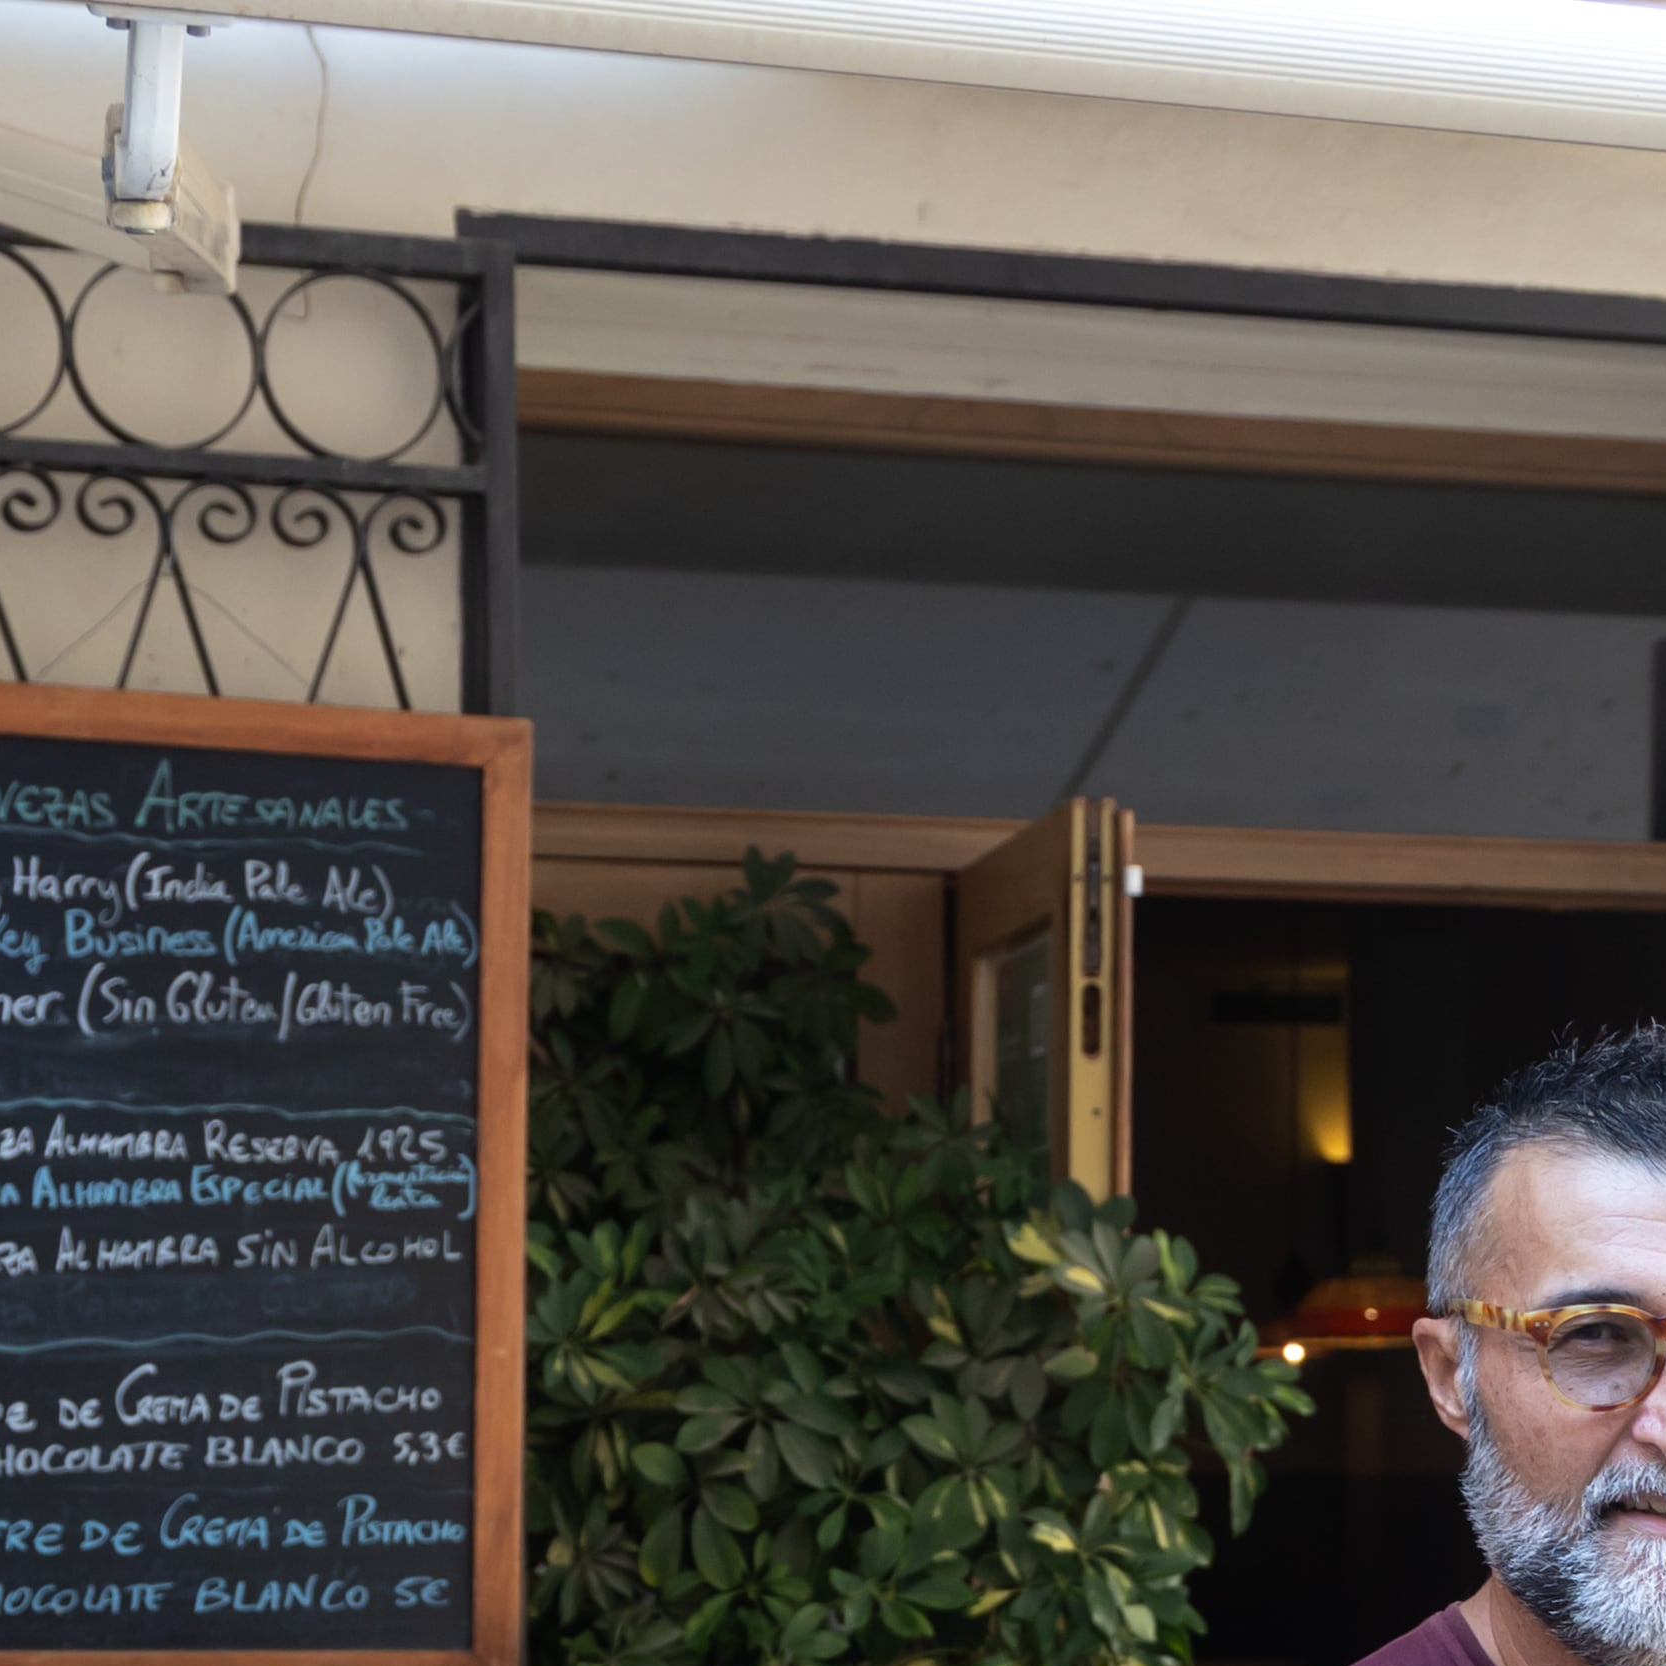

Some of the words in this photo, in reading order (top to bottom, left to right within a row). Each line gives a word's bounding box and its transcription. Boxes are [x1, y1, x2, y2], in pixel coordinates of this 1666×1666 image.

[12, 855, 123, 926] Harry
[125, 851, 233, 911] (India
[244, 859, 309, 905] Pale
[321, 863, 394, 923] Ale)
[64, 907, 217, 958] Business
[363, 916, 416, 955] Pale
[77, 962, 157, 1035] (Sin
[397, 979, 473, 1043] Free)
[356, 1124, 449, 1162] 1925
[32, 1165, 182, 1210] ALHAMBRA
[58, 1397, 103, 1429] DE
[114, 1362, 210, 1426] CREMA
[218, 1392, 264, 1423] DE
[204, 1434, 367, 1468] BLANCO
[80, 1519, 144, 1556] DE
[160, 1492, 270, 1549] CREMA
[281, 1518, 328, 1549] DE
[193, 1573, 370, 1614] BLANCO
[393, 1575, 452, 1609] 5€
